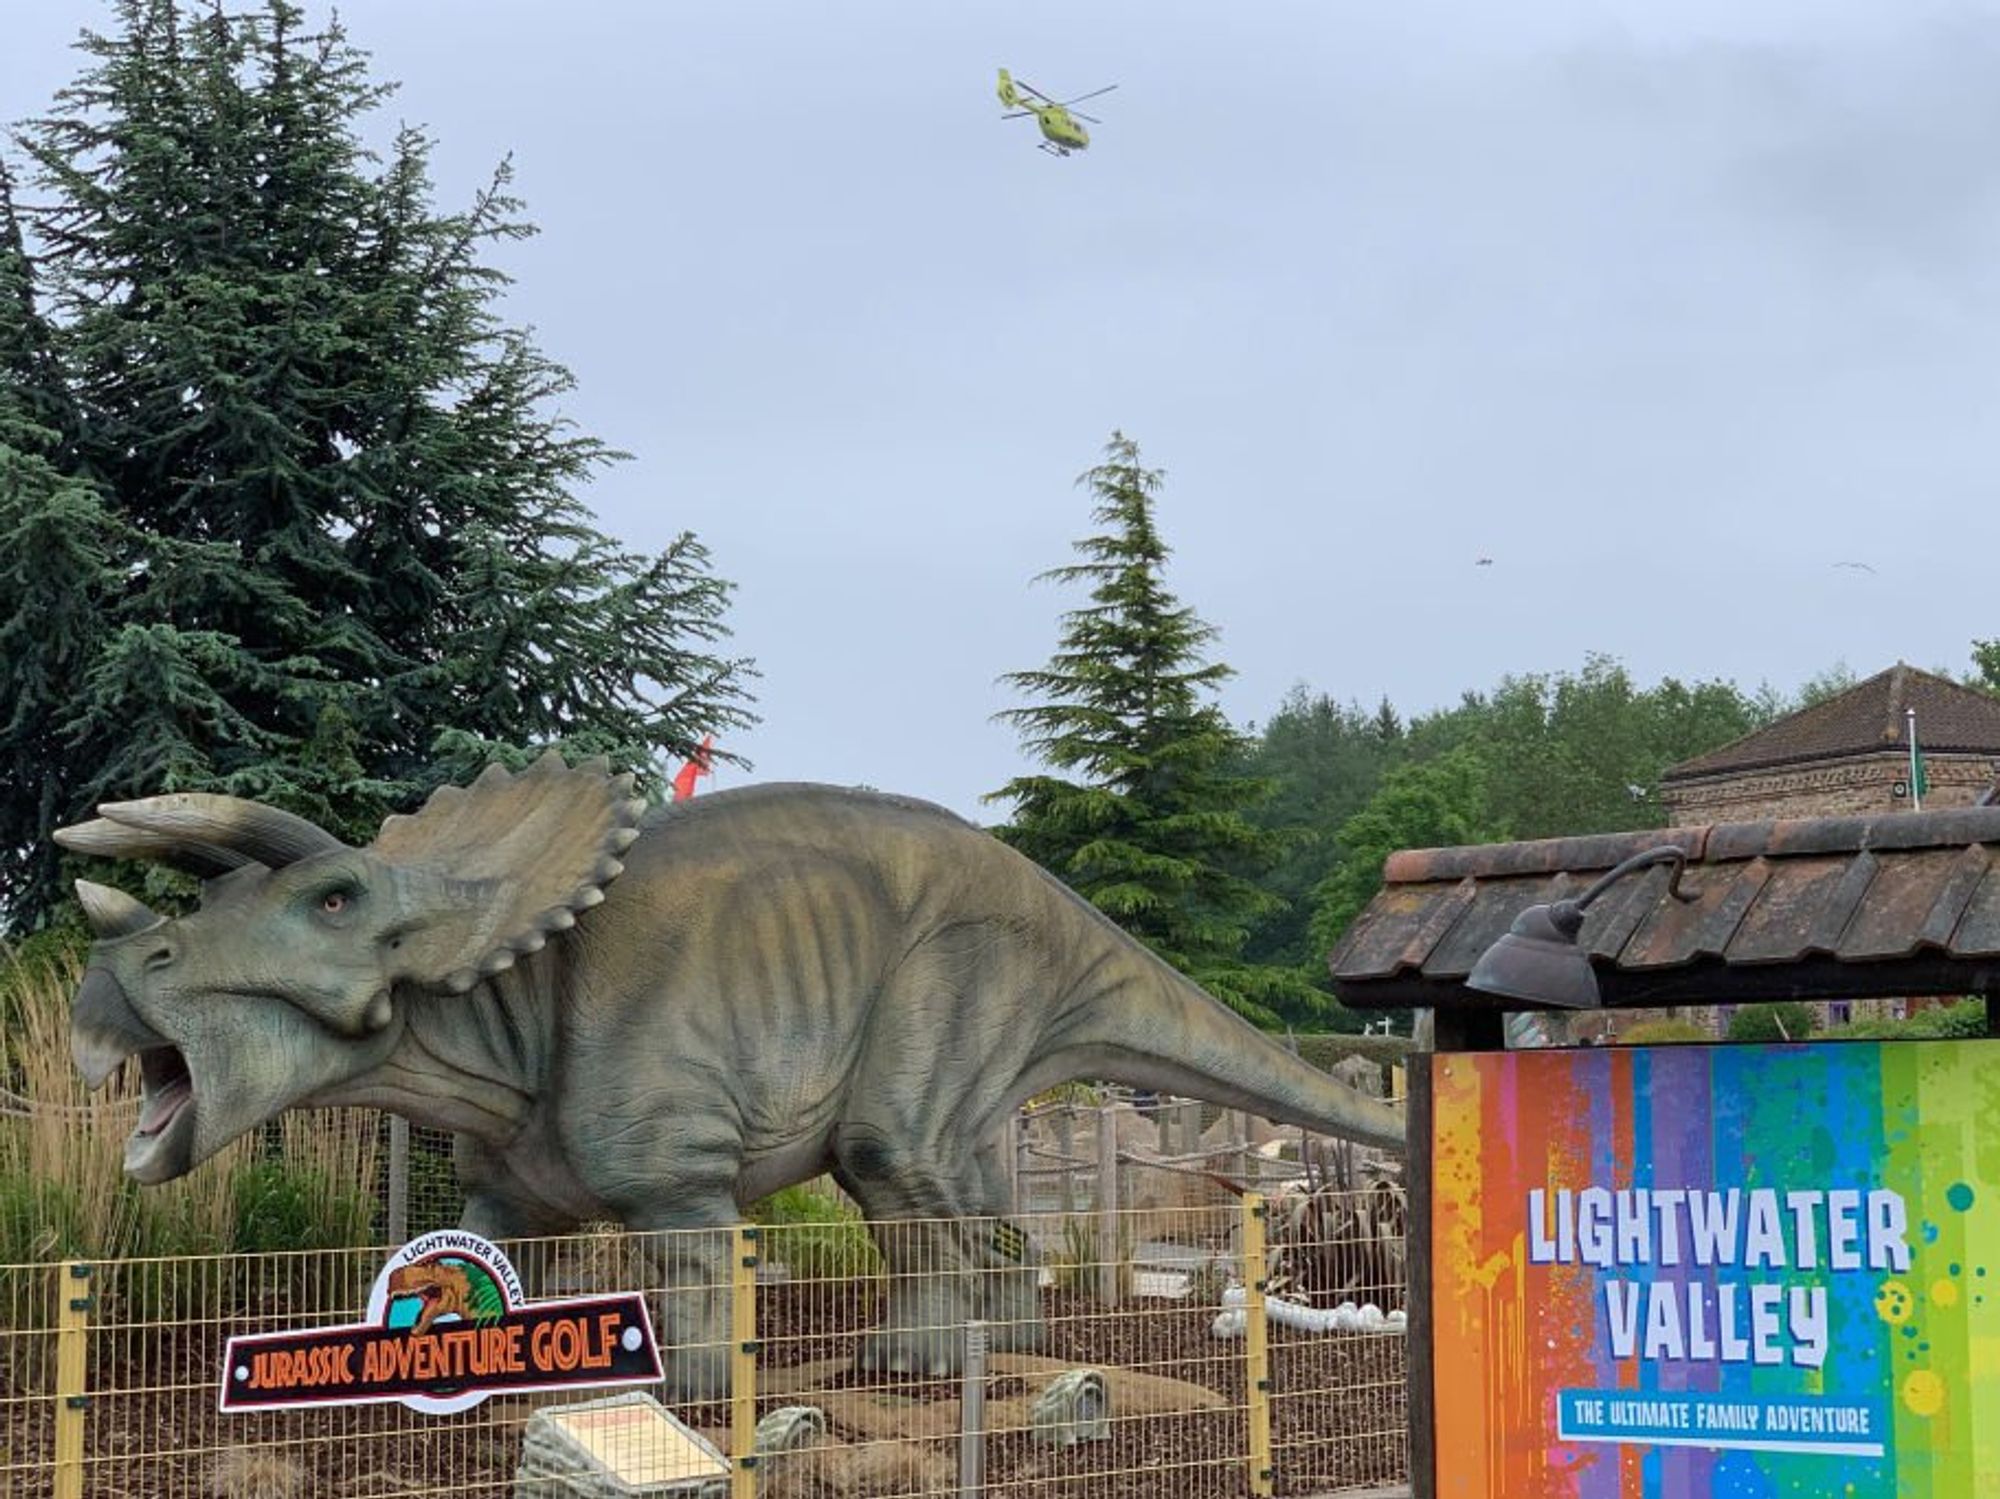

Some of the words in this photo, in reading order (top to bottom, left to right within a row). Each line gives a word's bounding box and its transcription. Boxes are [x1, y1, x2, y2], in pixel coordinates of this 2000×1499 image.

[1529, 1187, 1911, 1272] LIGHTWATER
[403, 1234, 492, 1263] LIGHTWATER
[492, 1252, 525, 1309] VALLEY
[248, 1342, 354, 1390] JURASSIC
[362, 1324, 526, 1383] ADVENTURE
[531, 1312, 621, 1372] GOLF
[1605, 1279, 1829, 1370] VALLEY
[1574, 1400, 1604, 1427] THE
[1609, 1401, 1689, 1430] ULTIMATE
[1698, 1404, 1759, 1431] FAMILY
[1766, 1404, 1870, 1434] ADVENTURE
